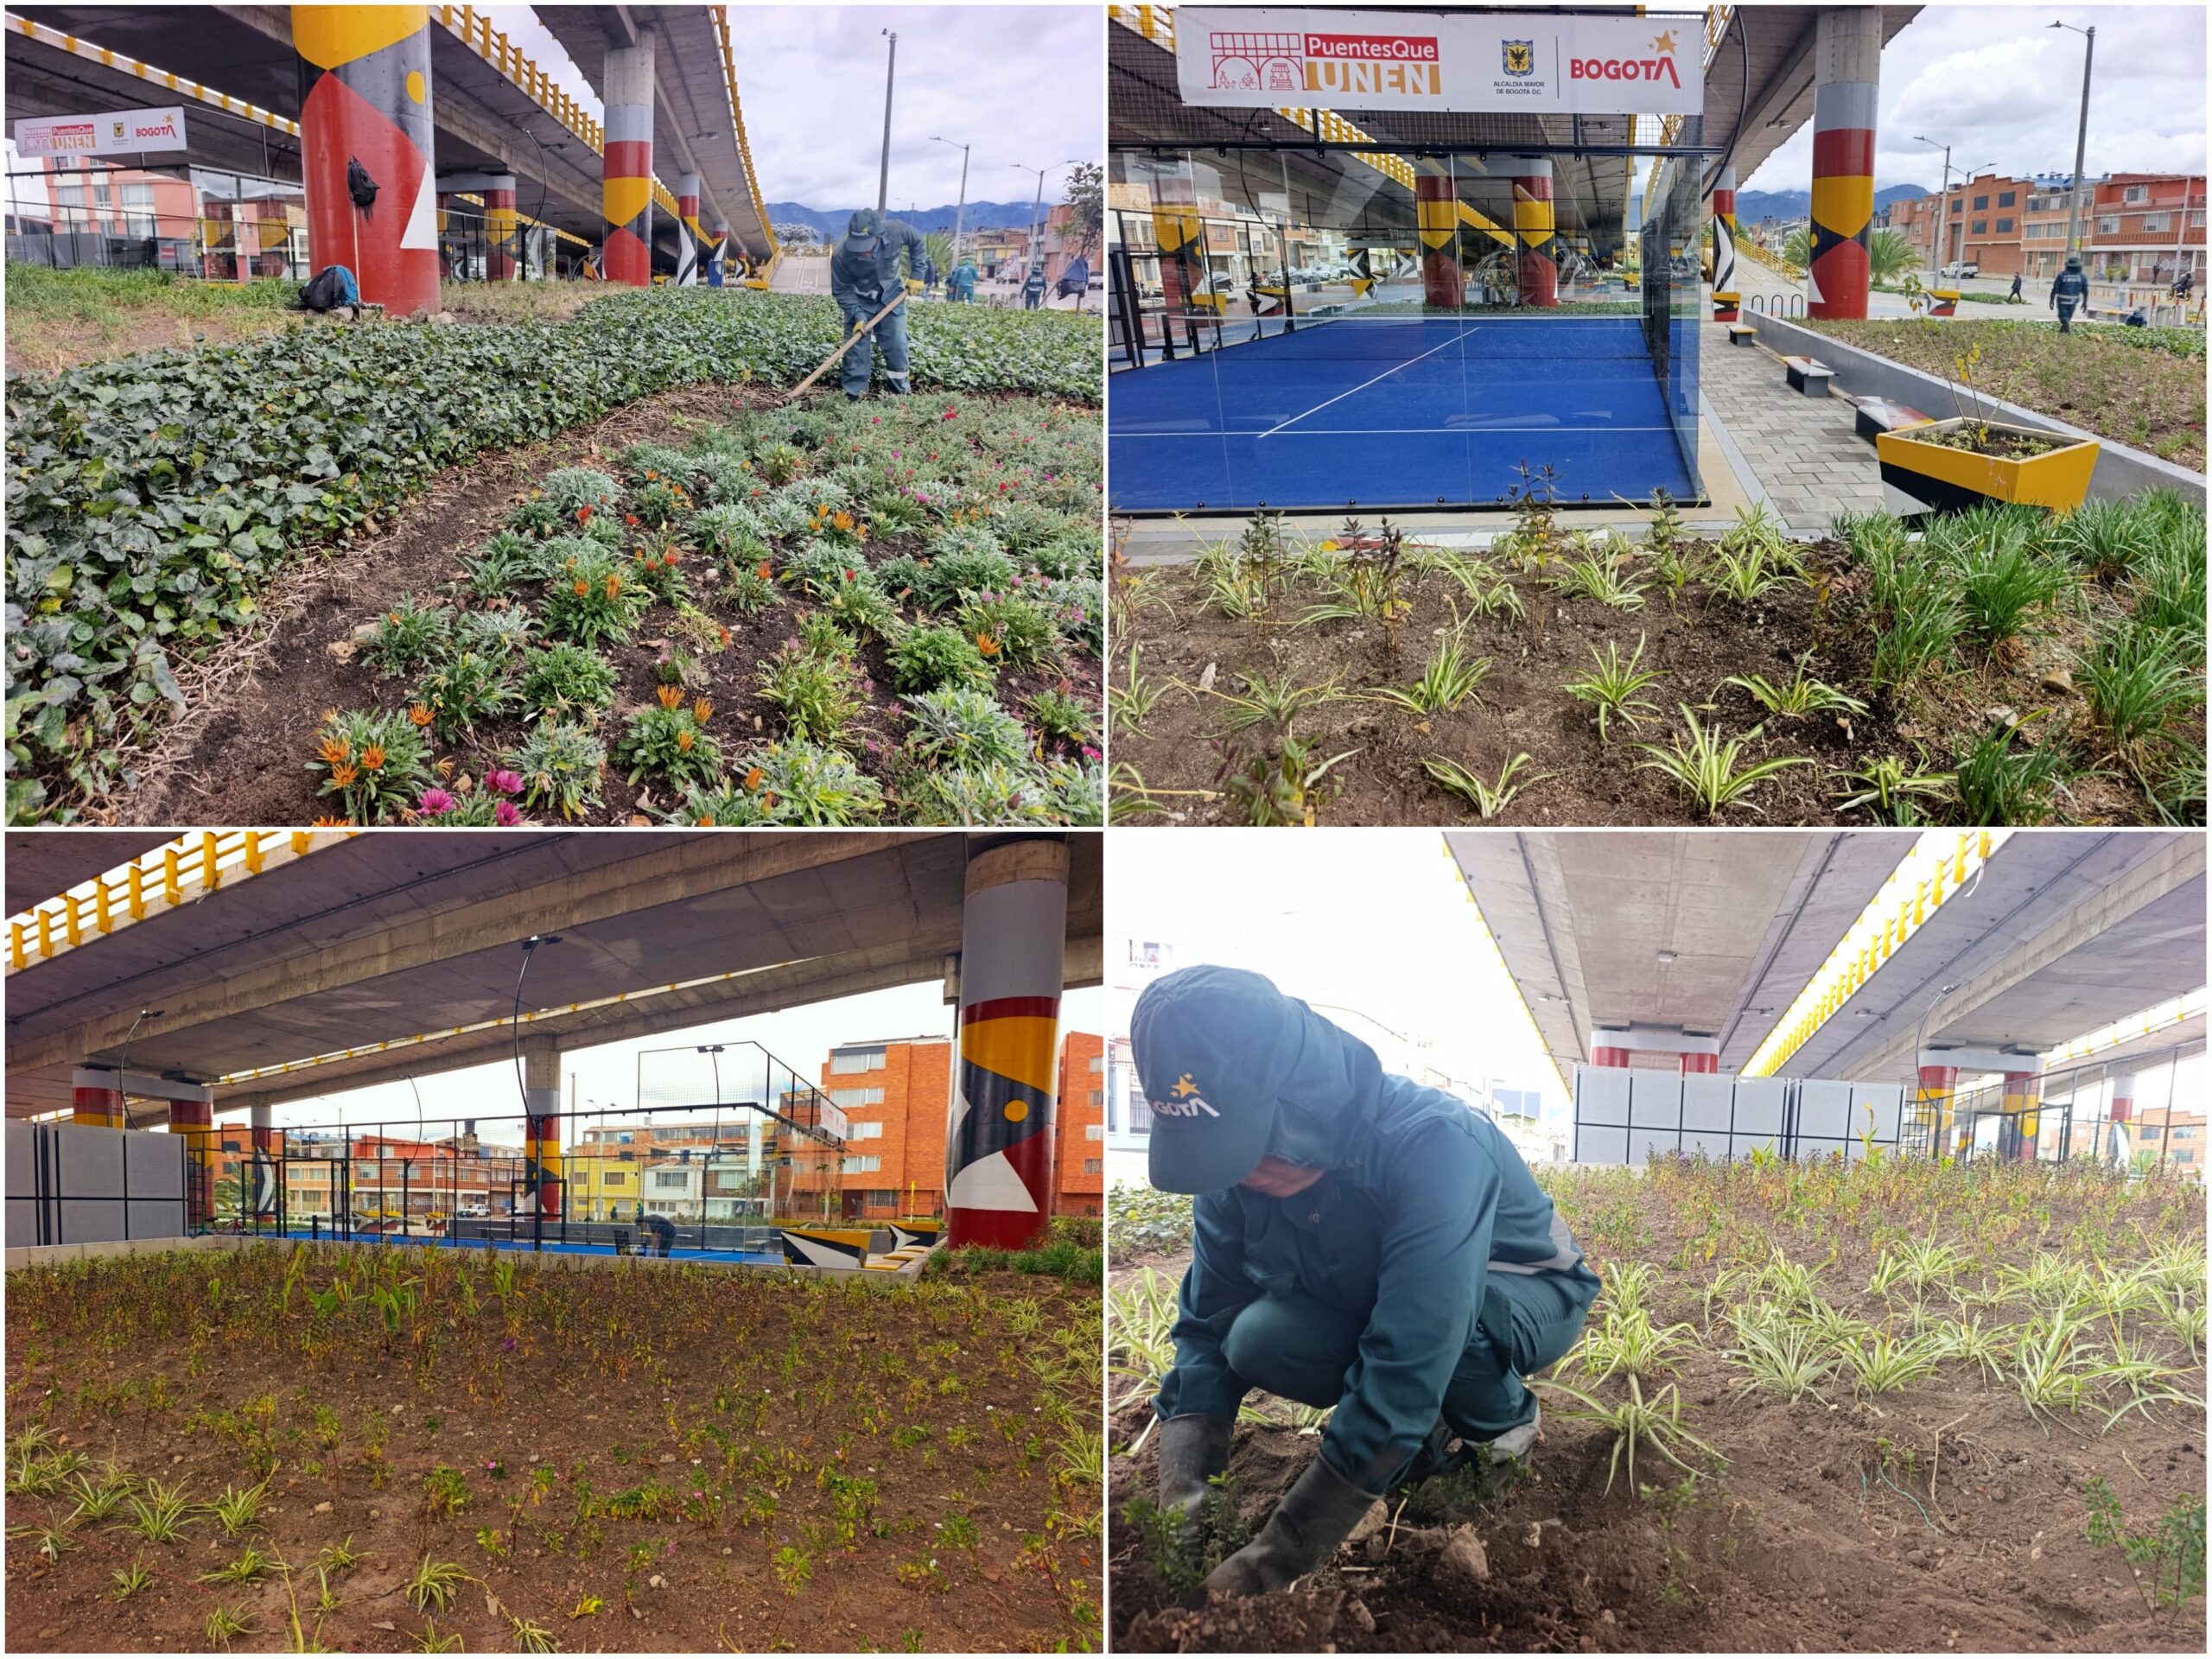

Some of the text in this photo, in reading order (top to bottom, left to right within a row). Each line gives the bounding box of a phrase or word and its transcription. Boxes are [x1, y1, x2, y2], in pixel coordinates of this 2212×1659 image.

[1308, 36, 1435, 59] PuentesQue
[1316, 61, 1432, 92] UNEN
[53, 126, 93, 135] PuentesQue
[56, 136, 92, 149] UNEN
